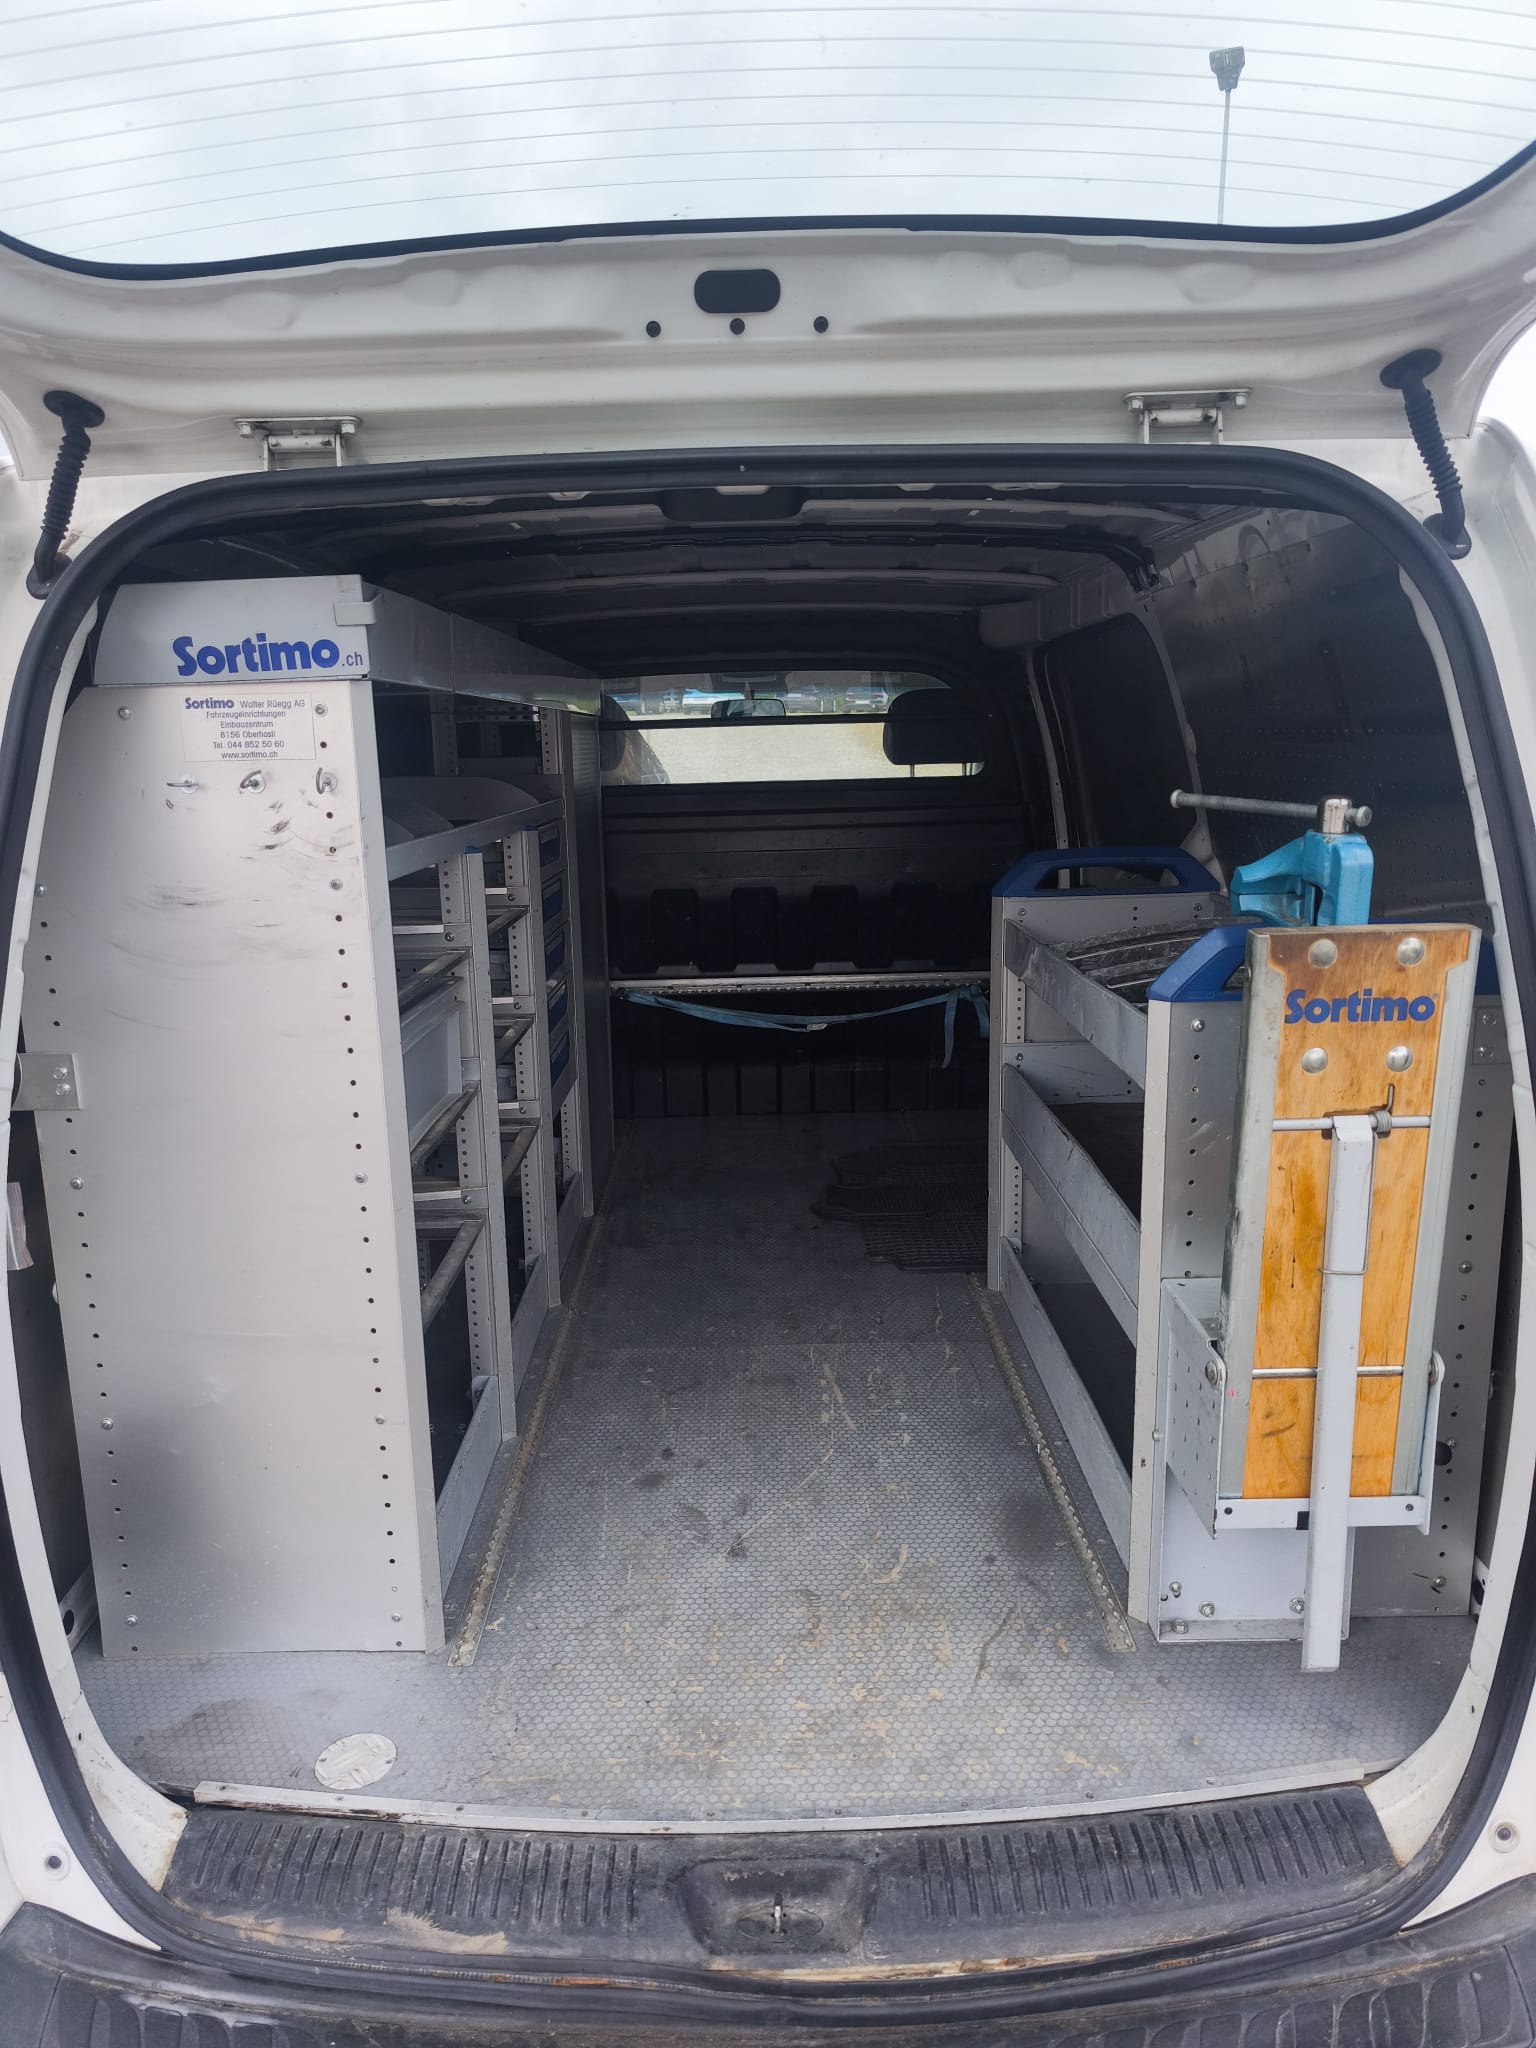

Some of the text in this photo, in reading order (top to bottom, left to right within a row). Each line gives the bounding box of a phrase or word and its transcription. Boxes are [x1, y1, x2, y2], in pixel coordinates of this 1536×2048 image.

[185, 697, 305, 711] Sortimo Walter Rüegg AG
[206, 710, 286, 720] Fahrzeugeinrichtungen
[220, 720, 274, 729] Einbauzentrum
[220, 730, 276, 739] 8156 Oberhasli
[212, 740, 285, 749] Tel. 044 852 50 60
[221, 750, 279, 759] www.sortimo.ch
[1285, 988, 1435, 1024] Sortimo
